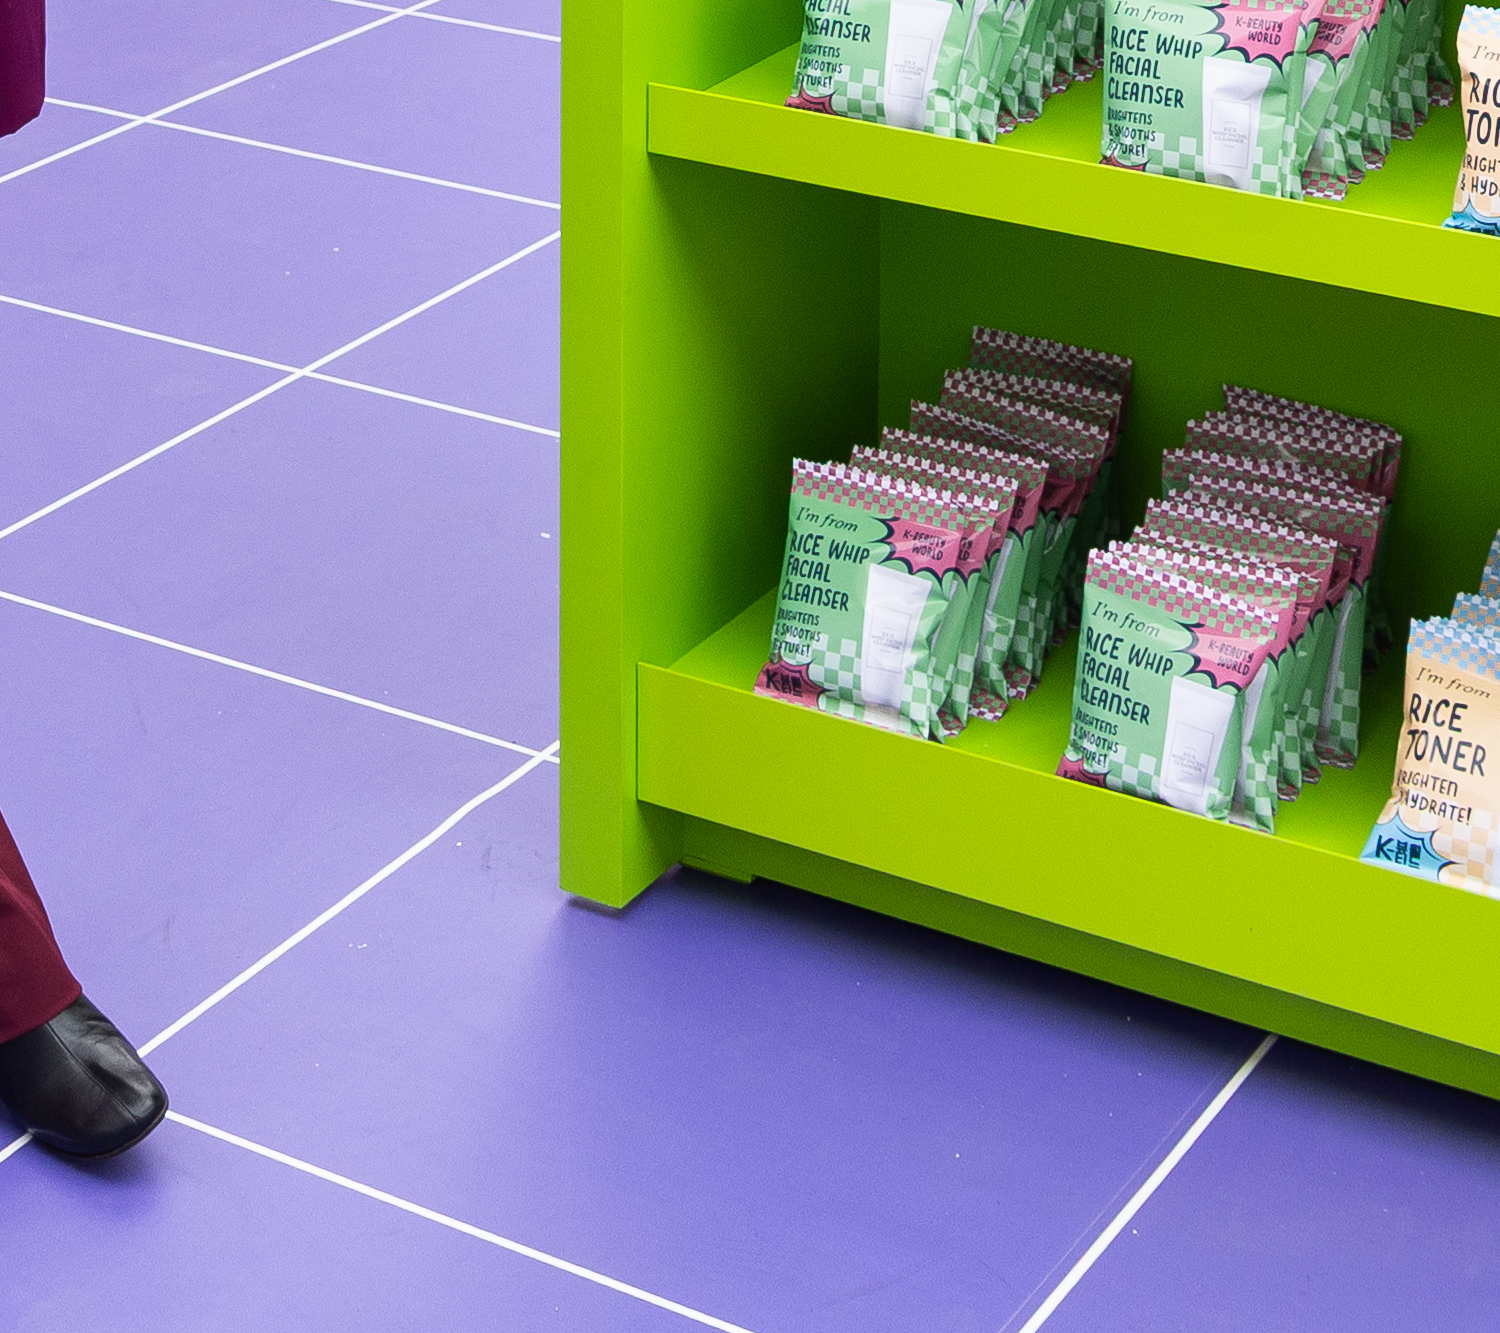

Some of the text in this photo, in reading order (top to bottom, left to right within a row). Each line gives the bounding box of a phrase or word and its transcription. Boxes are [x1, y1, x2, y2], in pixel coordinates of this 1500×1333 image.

[790, 531, 869, 564] RICE WHIP
[786, 555, 830, 583] FACIAL
[782, 582, 848, 611] CLEANSER
